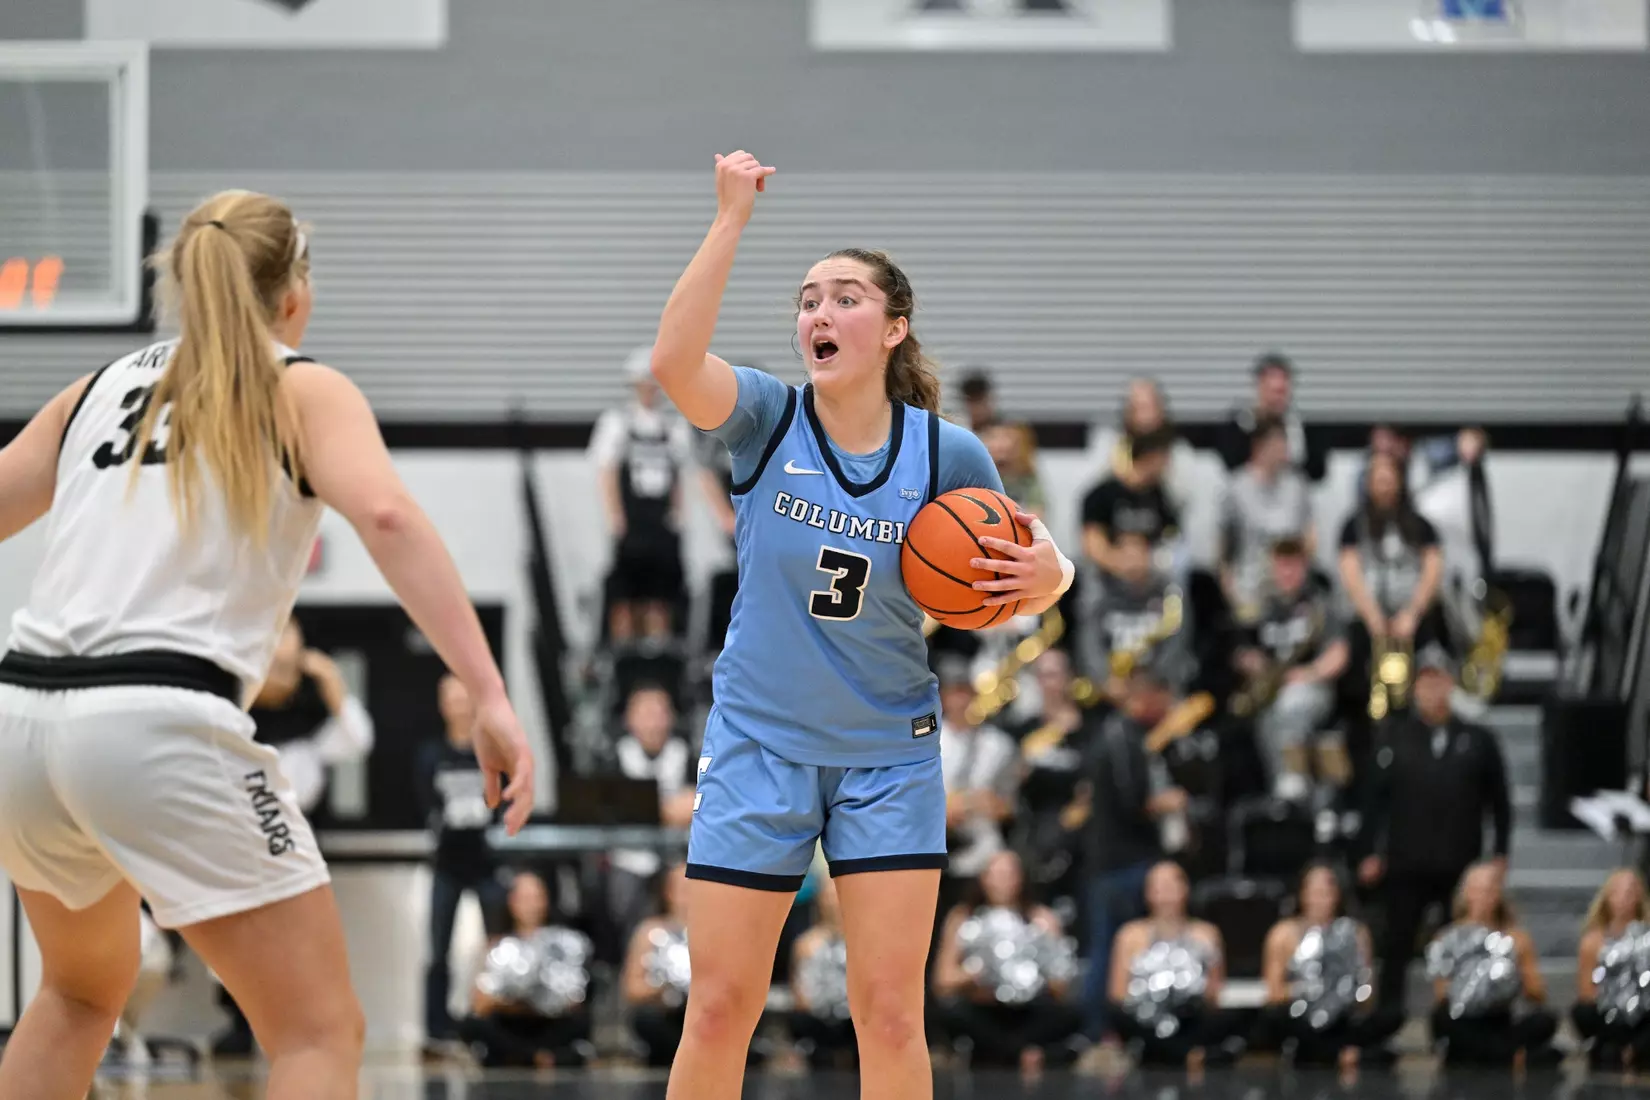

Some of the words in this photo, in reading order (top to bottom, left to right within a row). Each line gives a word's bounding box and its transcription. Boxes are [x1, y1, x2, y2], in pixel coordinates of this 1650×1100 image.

[773, 491, 905, 544] COLUMBI
[808, 544, 873, 622] 3
[244, 769, 296, 857] FRIARS
